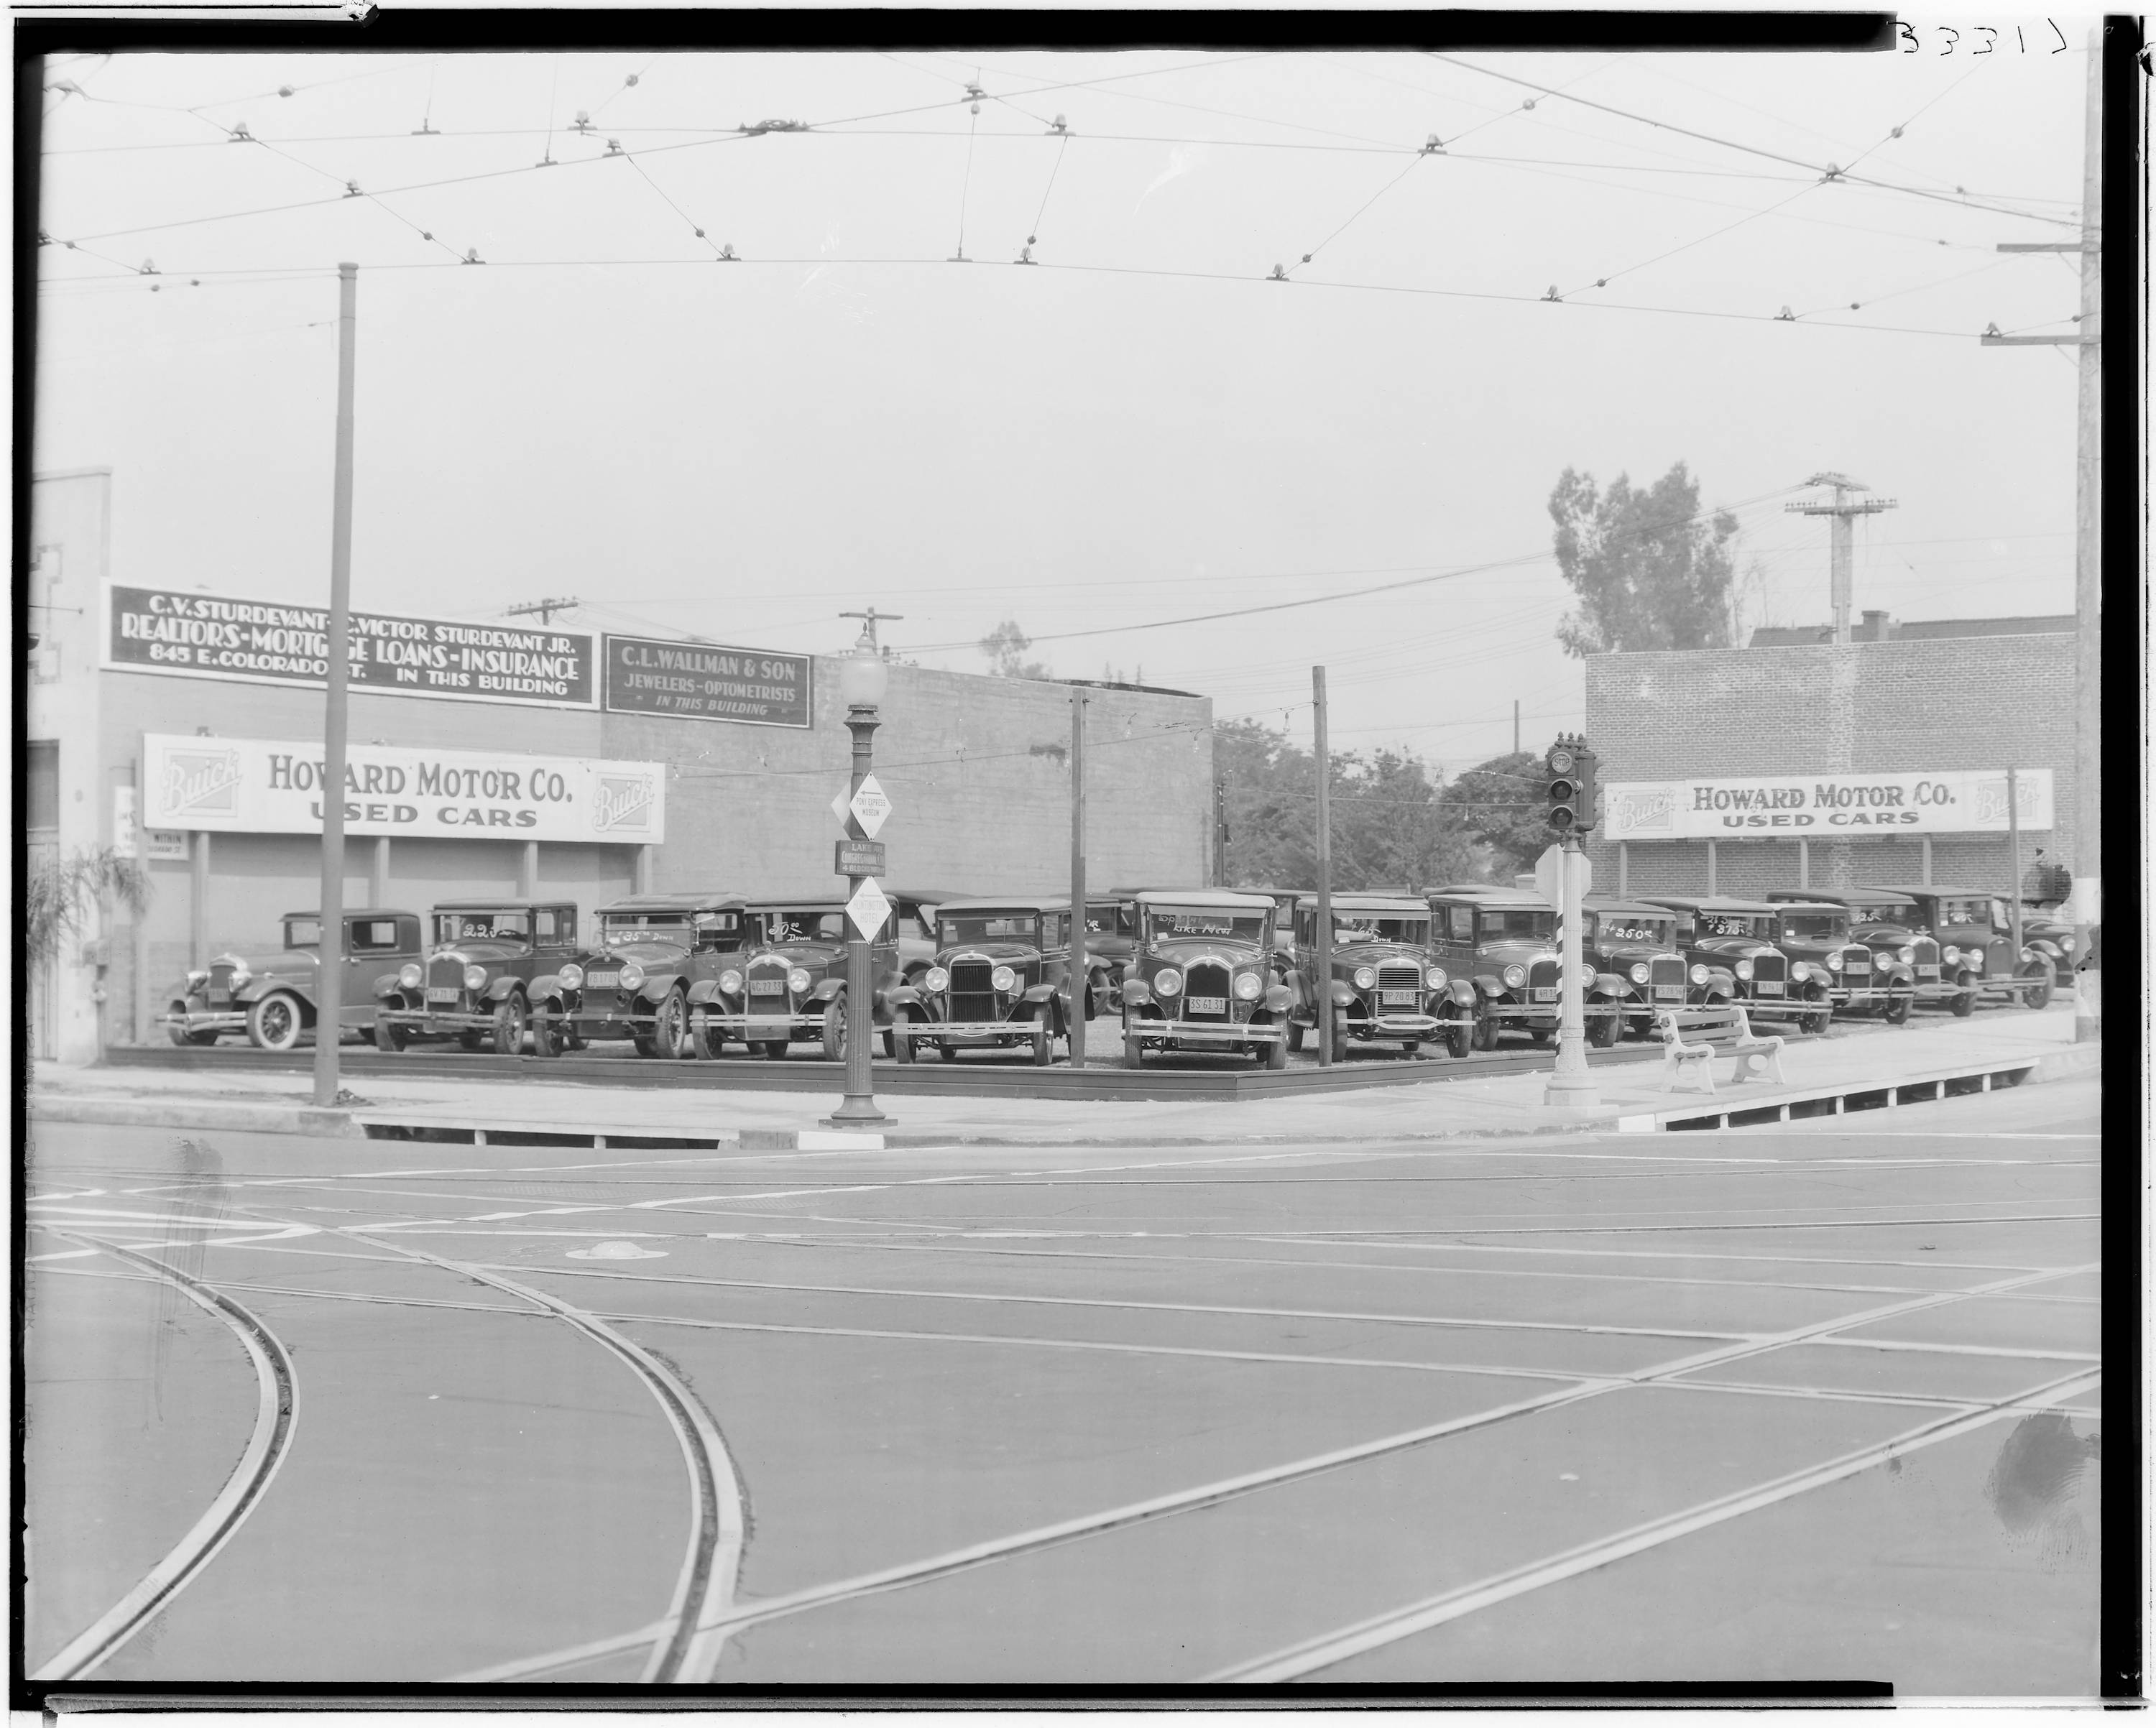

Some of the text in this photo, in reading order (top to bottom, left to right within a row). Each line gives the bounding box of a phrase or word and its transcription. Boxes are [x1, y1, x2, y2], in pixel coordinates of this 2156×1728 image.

[434, 625, 545, 652] STURDEVANT
[547, 637, 576, 655] JR.
[149, 644, 191, 662] 845
[348, 663, 367, 678] T.
[397, 667, 418, 683] IN
[426, 670, 471, 687] THIS
[479, 675, 568, 696] BUILDING
[743, 659, 755, 677] &
[760, 660, 796, 681] SON
[655, 695, 768, 716] IN THIS BUILDING
[160, 747, 243, 817] Buick
[416, 762, 522, 800] MOTOR
[591, 772, 655, 833] Buick
[867, 798, 885, 807] EXPRESS
[1692, 787, 1806, 810] HOWARD
[1814, 784, 1904, 808] MOTOR
[437, 807, 537, 828] CARS
[862, 808, 880, 816] MUSEUM
[1617, 787, 1675, 833] Buick
[1723, 812, 1920, 827] USED CARS
[1190, 998, 1224, 1009] 3S 61 31
